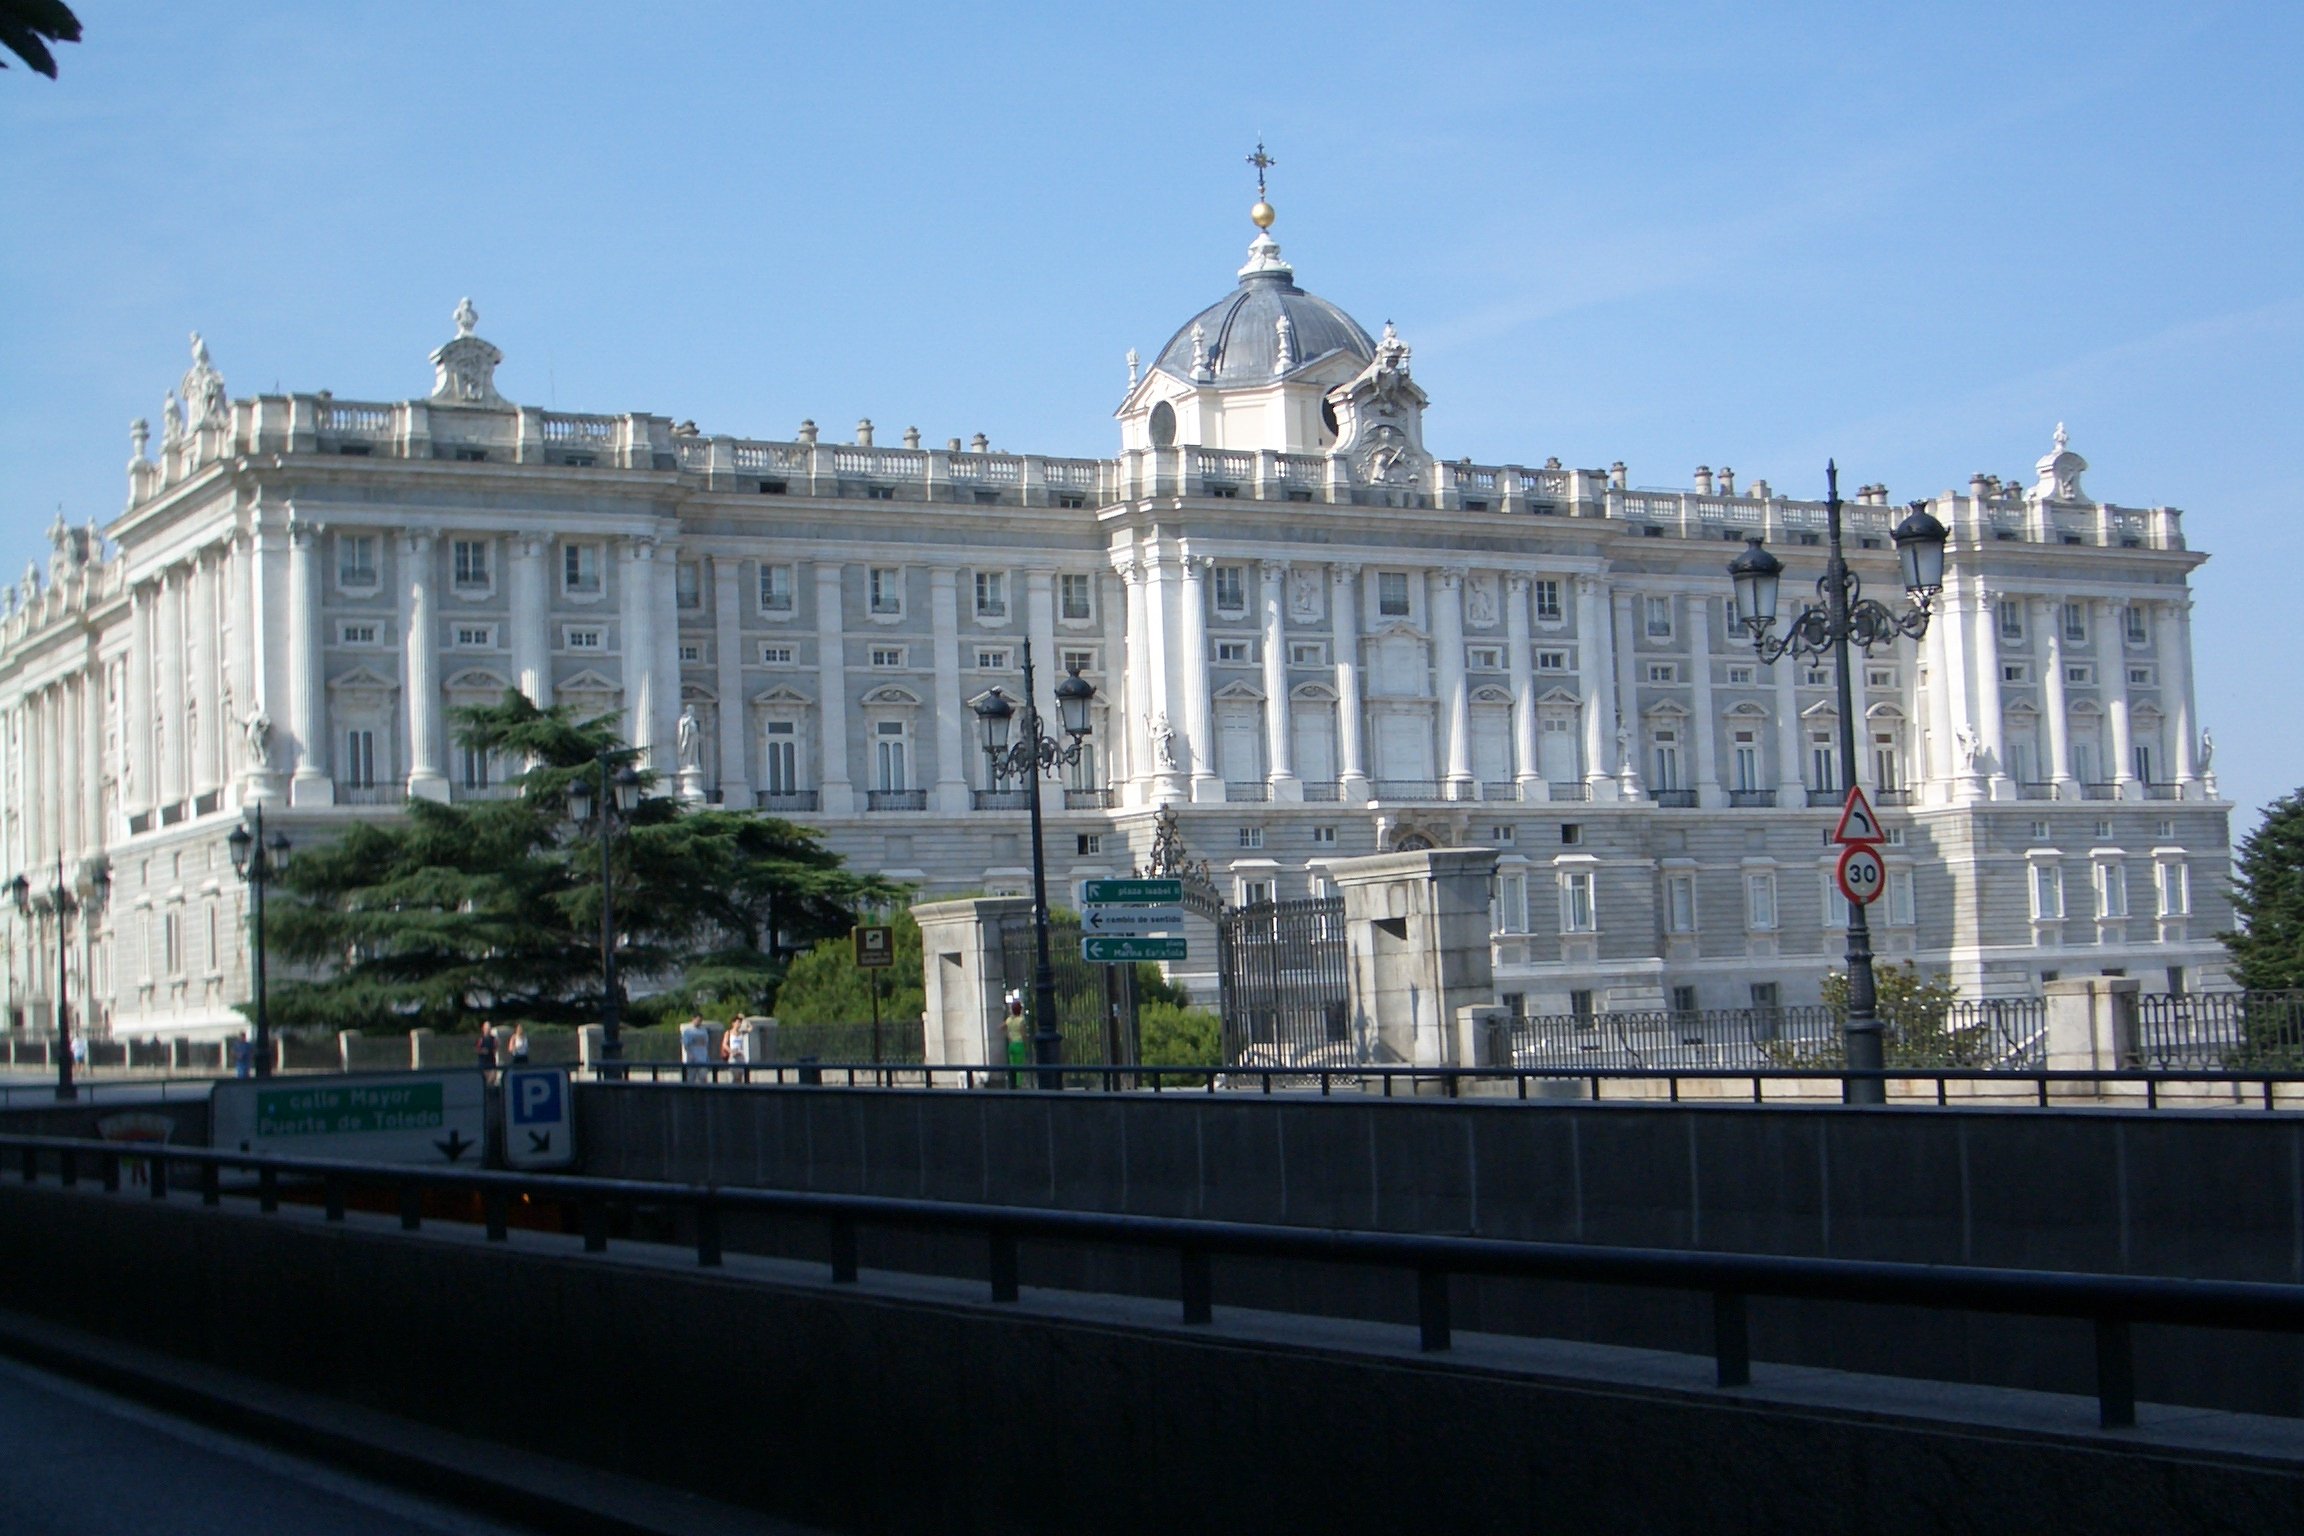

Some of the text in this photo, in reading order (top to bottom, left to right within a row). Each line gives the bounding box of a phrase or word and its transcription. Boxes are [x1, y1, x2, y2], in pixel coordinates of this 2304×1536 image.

[1849, 864, 1877, 884] 30
[1118, 886, 1142, 897] plaza
[1113, 948, 1142, 957] Marina
[350, 1087, 412, 1108] Mayor
[522, 1078, 551, 1117] P
[259, 1110, 441, 1135] Puerta de Toledo
